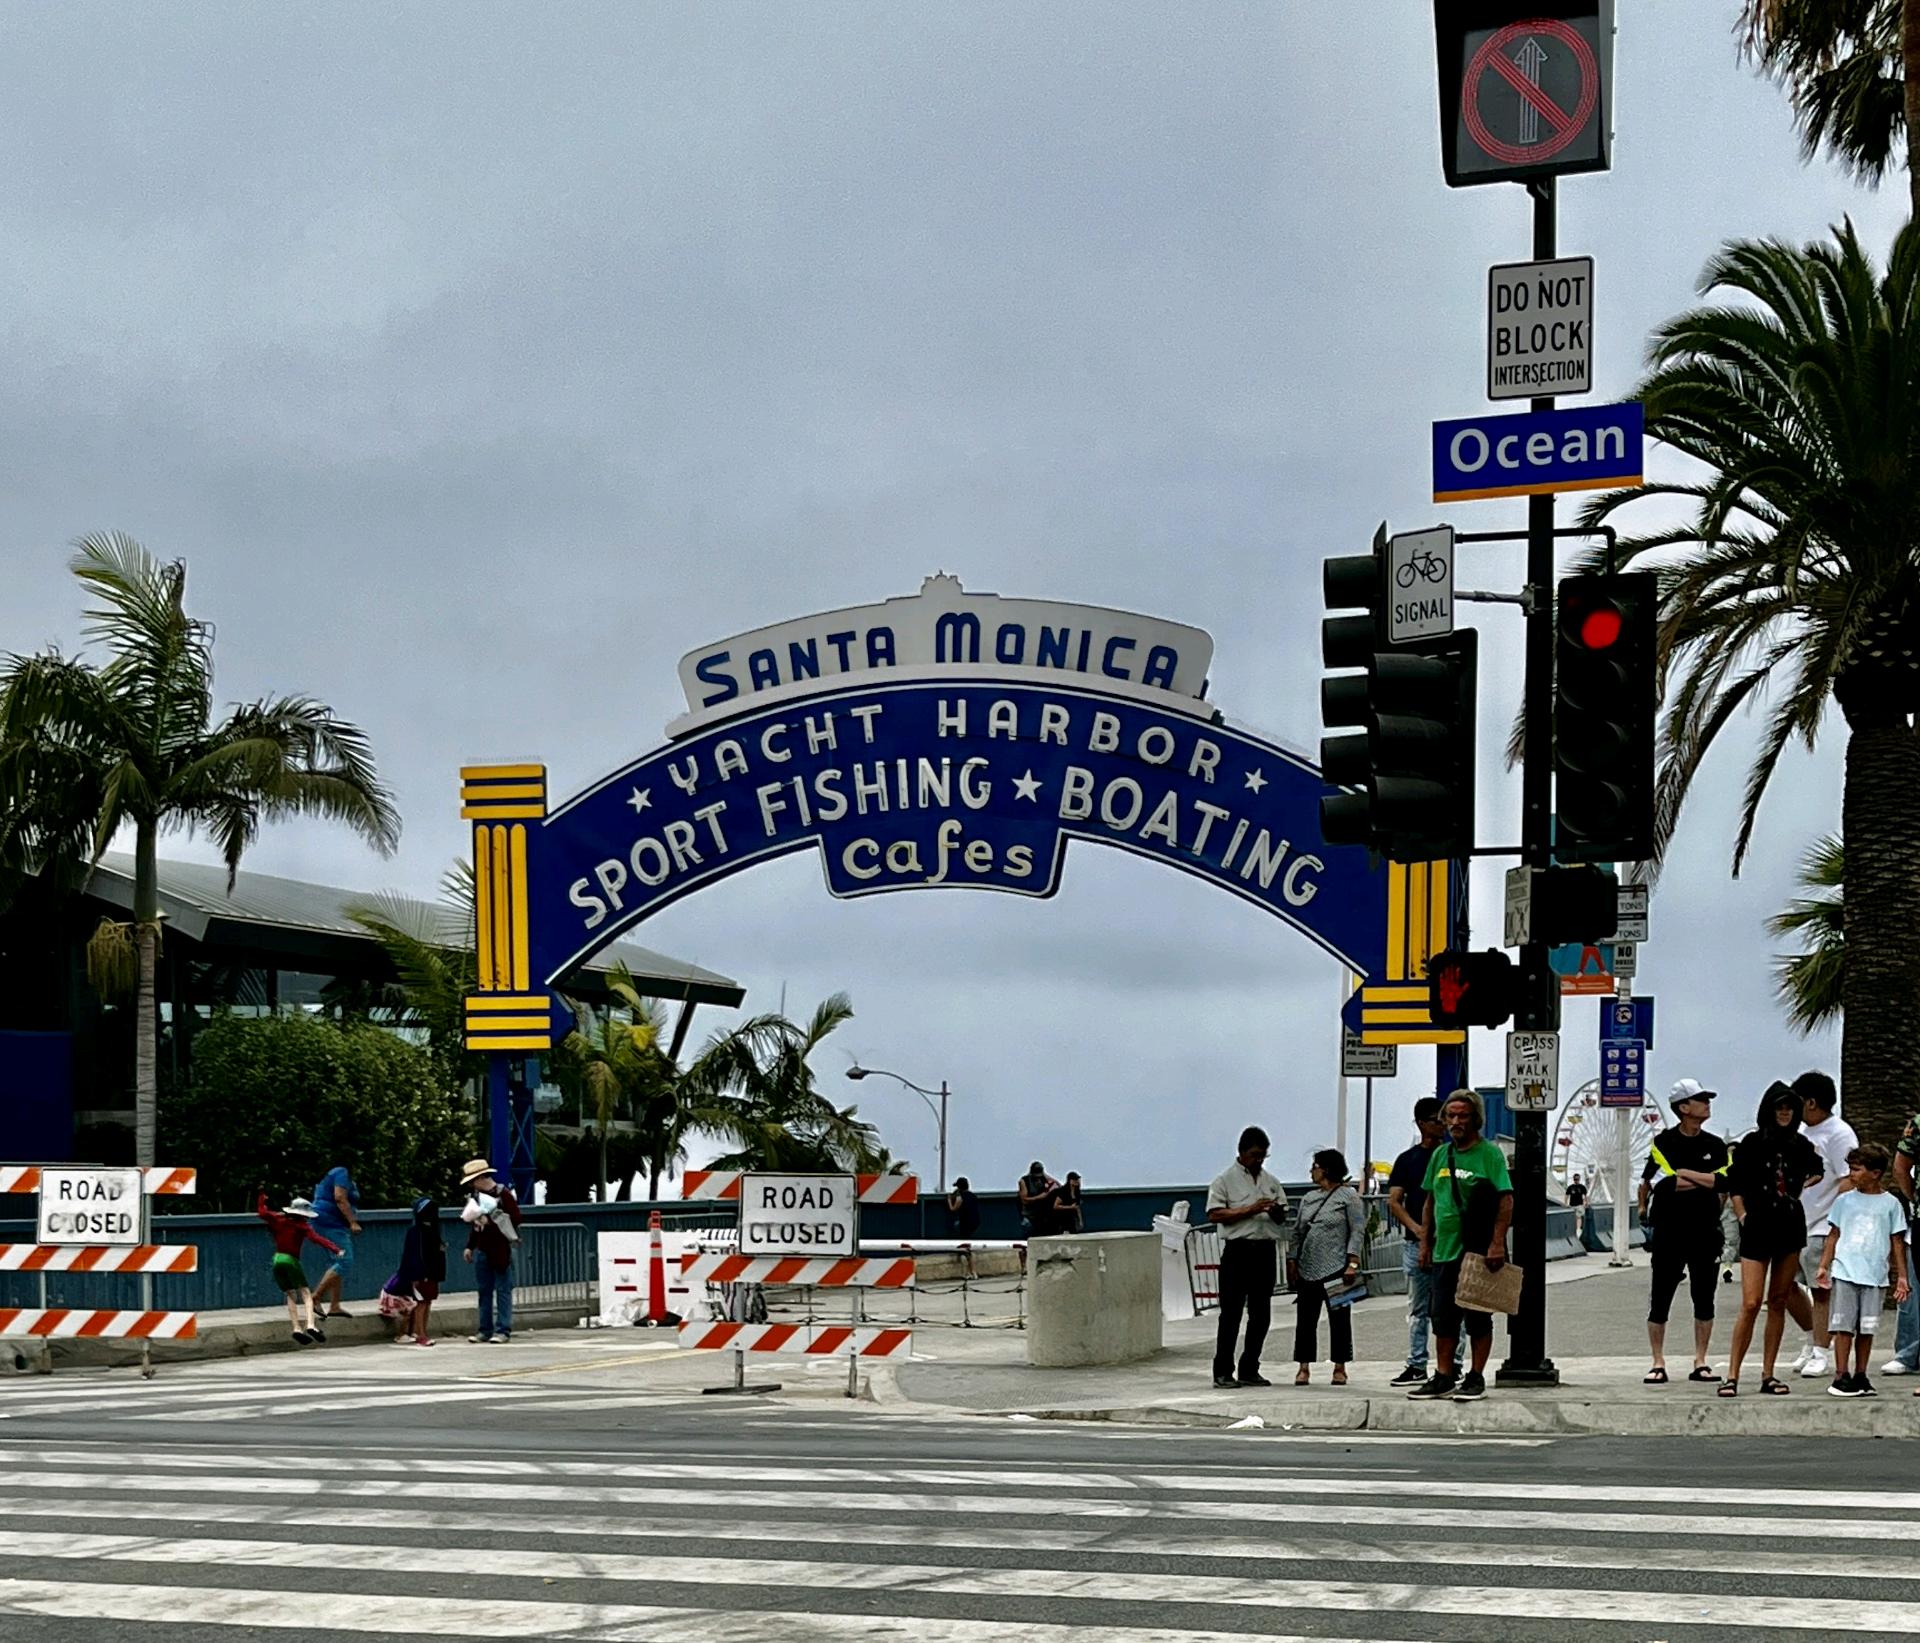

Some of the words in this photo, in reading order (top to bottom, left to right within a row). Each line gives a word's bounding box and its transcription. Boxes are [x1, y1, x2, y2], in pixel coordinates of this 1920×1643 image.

[1497, 281, 1528, 313] DO
[1538, 276, 1585, 309] NOT
[1496, 320, 1584, 356] BLOCK
[1495, 359, 1584, 386] INTERSECTION
[1450, 425, 1625, 473] Ocean
[1395, 597, 1448, 625] SIGNAL
[695, 626, 896, 708] SANTA
[935, 612, 1178, 690] MONICA
[668, 704, 882, 796] YACHT
[938, 699, 1221, 784] HARBOR
[568, 801, 728, 930] SPORT
[756, 756, 991, 837] FISHING
[1059, 766, 1324, 907] BOATING
[1514, 1036, 1554, 1050] CROSS
[1517, 1064, 1549, 1077] WALK
[1510, 1078, 1555, 1092] SINAL
[60, 1180, 124, 1201] ROAD
[763, 1186, 834, 1209] ROAD
[48, 1213, 132, 1234] COSED
[750, 1222, 845, 1245] CLOSED
